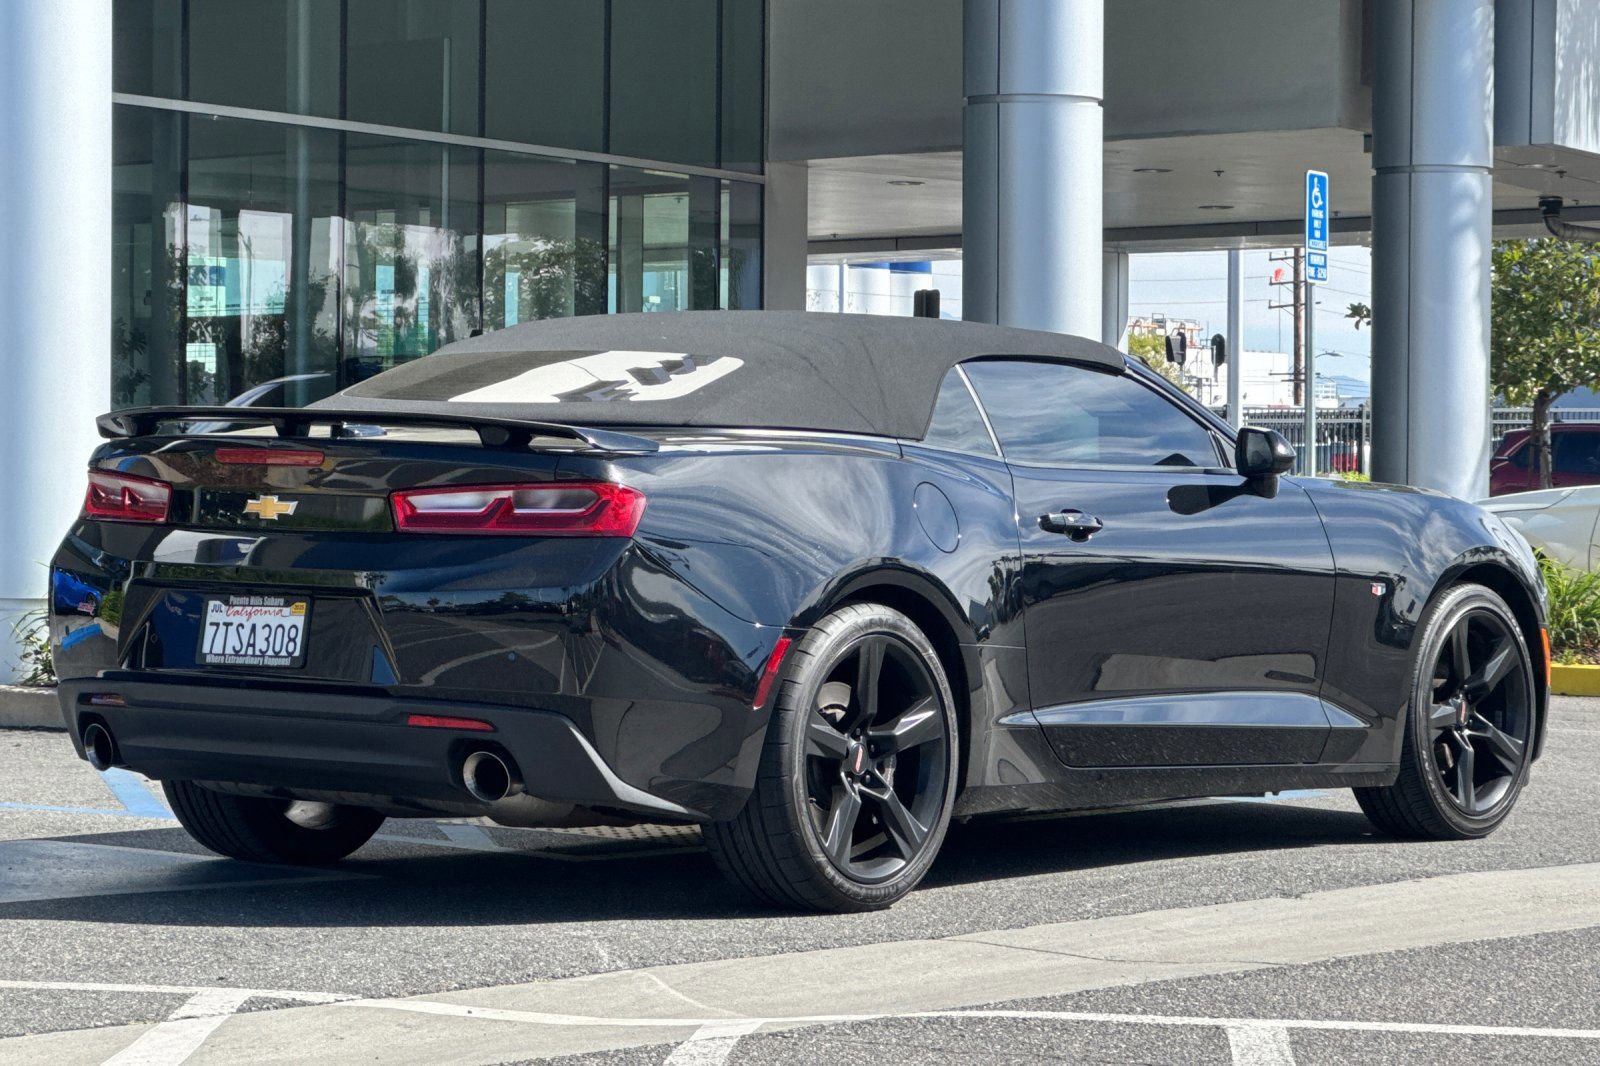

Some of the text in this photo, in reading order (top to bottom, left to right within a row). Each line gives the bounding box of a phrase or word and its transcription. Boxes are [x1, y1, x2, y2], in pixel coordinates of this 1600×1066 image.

[230, 596, 285, 606] Puente Hills Subaru
[211, 604, 223, 613] JUL
[226, 604, 288, 621] California
[209, 622, 299, 656] 7TSA308
[206, 654, 291, 666] Where Extraordinary Happens!
